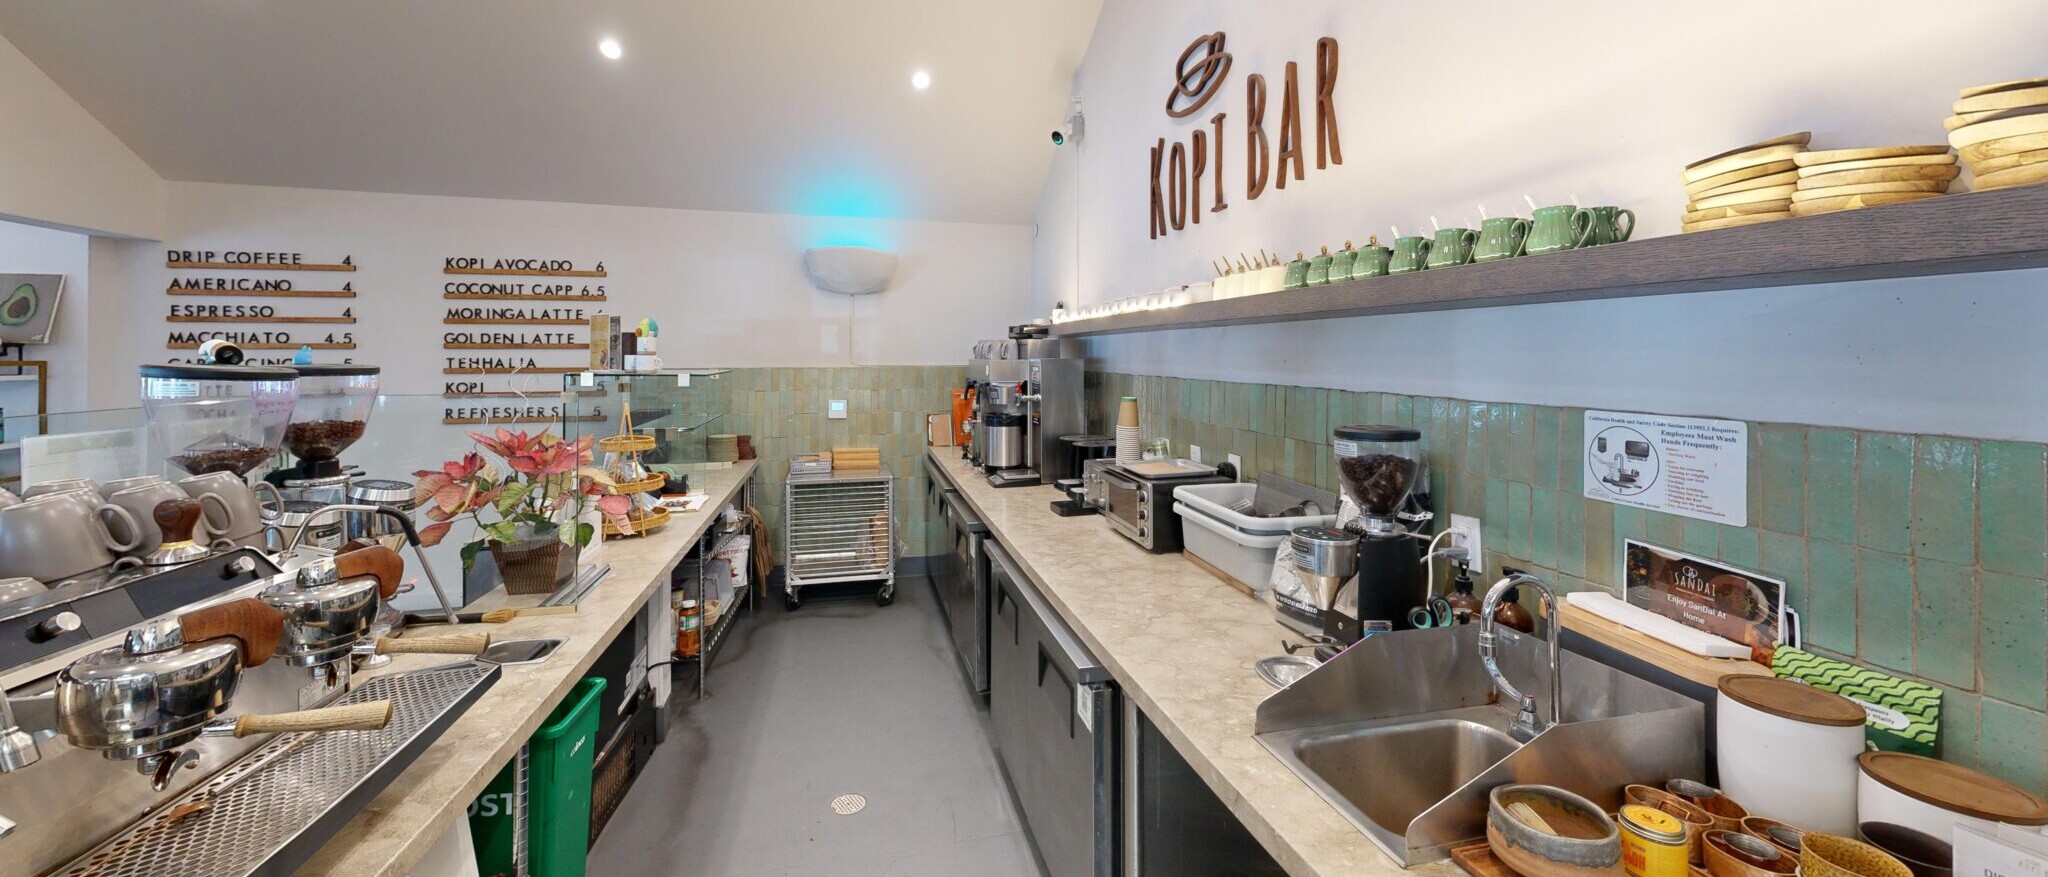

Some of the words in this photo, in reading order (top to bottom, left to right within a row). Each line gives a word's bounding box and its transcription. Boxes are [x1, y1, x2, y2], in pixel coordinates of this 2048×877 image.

[1150, 112, 1229, 240] KOPI
[1247, 36, 1343, 201] BAR
[167, 250, 215, 263] DRIP
[224, 251, 301, 265] COFFEE
[342, 254, 352, 265] 4
[445, 257, 485, 270] KOPI
[494, 258, 573, 272] AVOCADO
[596, 261, 605, 272] 6
[169, 277, 292, 292] AMERICANO
[342, 281, 352, 292] 4
[444, 282, 525, 295] COCONUT
[532, 283, 573, 296] CAPP
[581, 285, 605, 297] 6.5
[170, 304, 274, 318] ESPRESSO
[342, 307, 352, 318] 4
[168, 331, 290, 344] MACCHIATO
[324, 332, 352, 344] 4.5
[444, 332, 515, 345] GOLDEN
[521, 333, 576, 345] LATTE
[445, 382, 484, 394] KOPI
[596, 380, 605, 392] 5
[445, 406, 559, 420] REFRESHERS
[592, 405, 601, 417] 5
[1661, 429, 1695, 439] Employees
[1697, 433, 1715, 441] Must
[1716, 435, 1737, 443] Wash
[1661, 438, 1681, 446] Hands
[1683, 440, 1722, 451] Frequently:
[1674, 571, 1717, 597] SANDAI
[1667, 593, 1688, 608] Enjoy
[1717, 610, 1728, 620] At
[1683, 611, 1706, 625] Home
